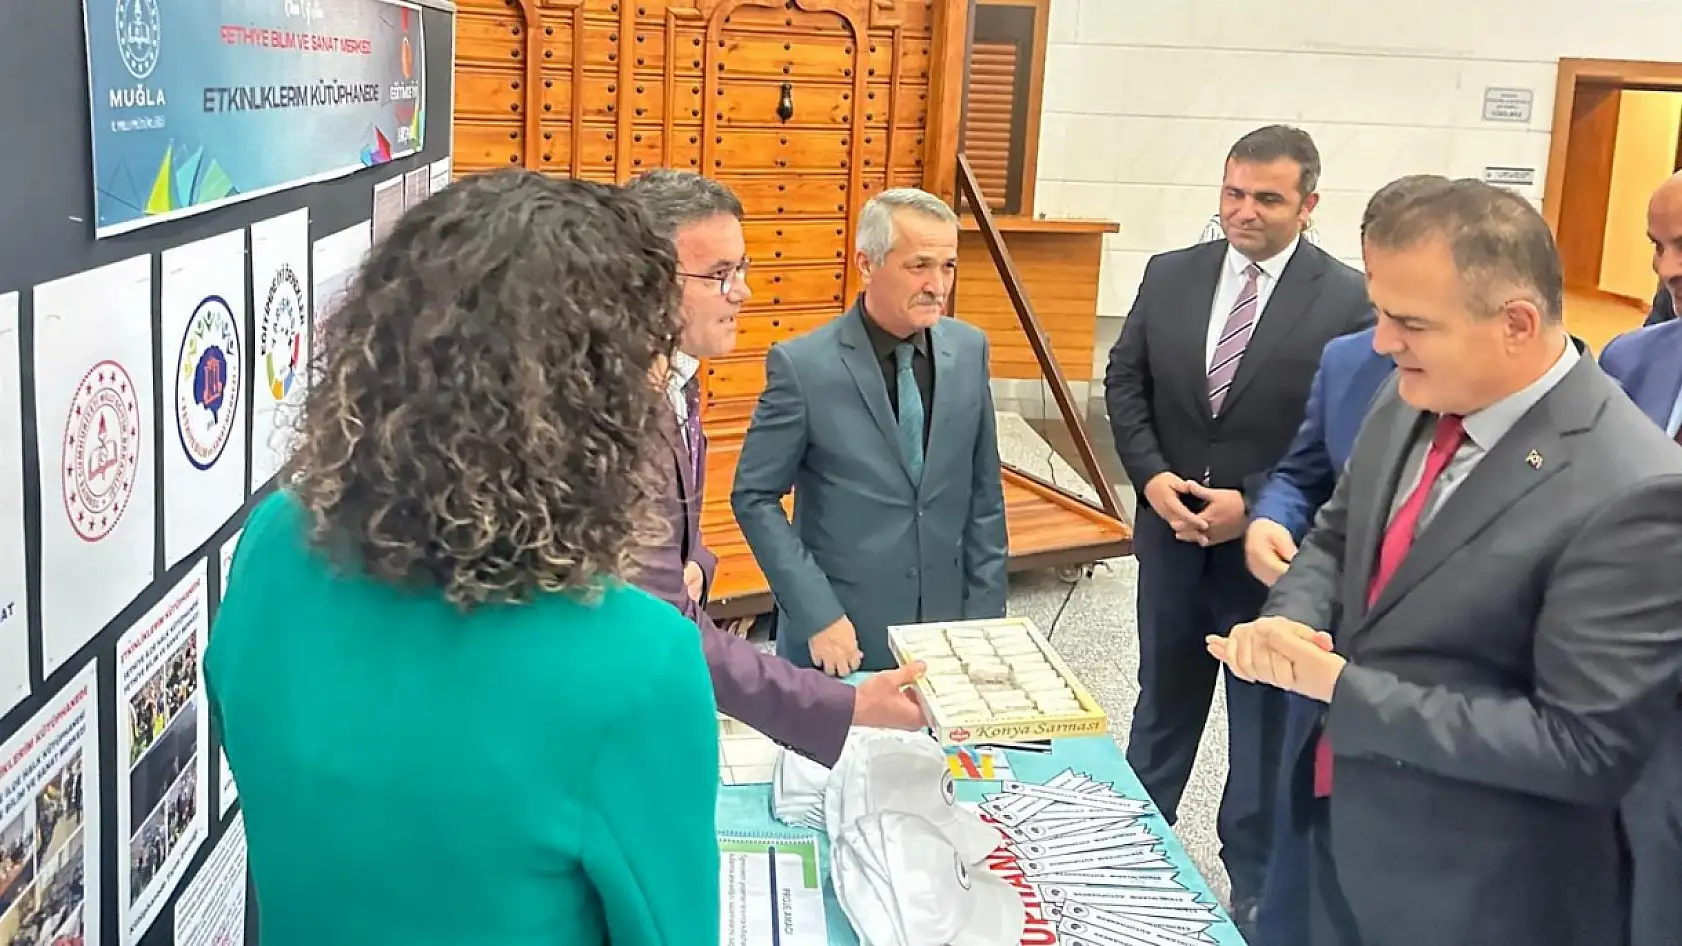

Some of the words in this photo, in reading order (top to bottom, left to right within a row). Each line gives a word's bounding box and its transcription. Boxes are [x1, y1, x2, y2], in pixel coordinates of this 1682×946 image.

[109, 83, 166, 108] MUĞLA
[311, 79, 379, 106] KÜTÜPHANEDE
[976, 724, 1030, 739] Konya
[1033, 720, 1100, 734] Sarması
